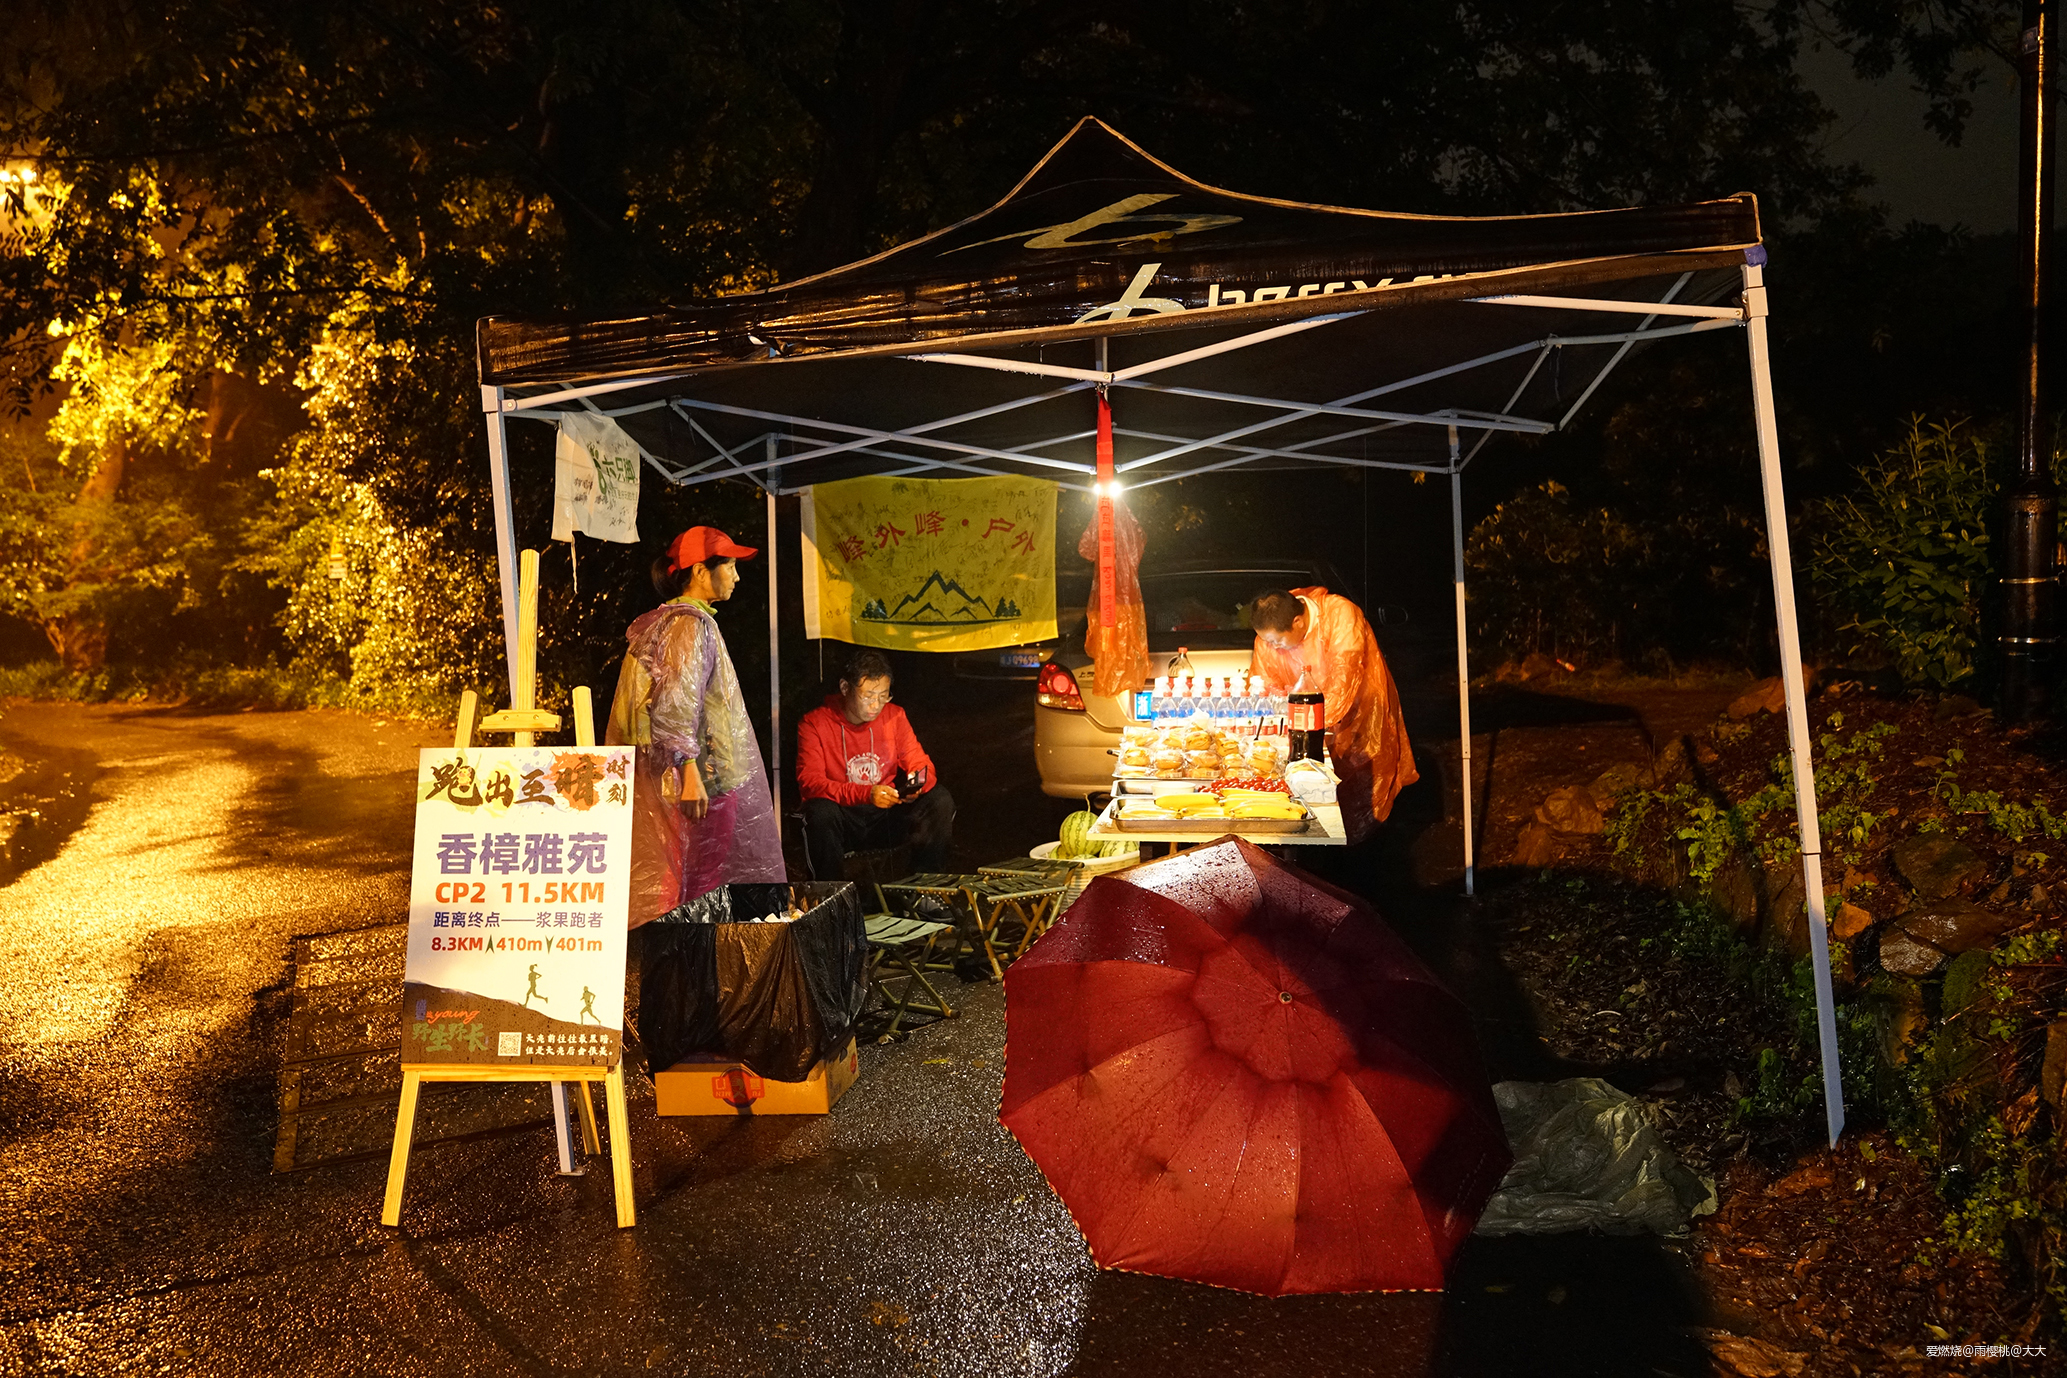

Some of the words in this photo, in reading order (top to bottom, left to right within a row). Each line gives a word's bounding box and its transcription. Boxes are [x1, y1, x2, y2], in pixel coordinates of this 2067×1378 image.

[436, 832, 608, 875] 香樟雅苑
[435, 882, 486, 904] CP2
[502, 882, 605, 904] 11.5KM
[431, 937, 484, 952] 8.3KM
[496, 937, 543, 952] 410m
[556, 937, 603, 952] 401m
